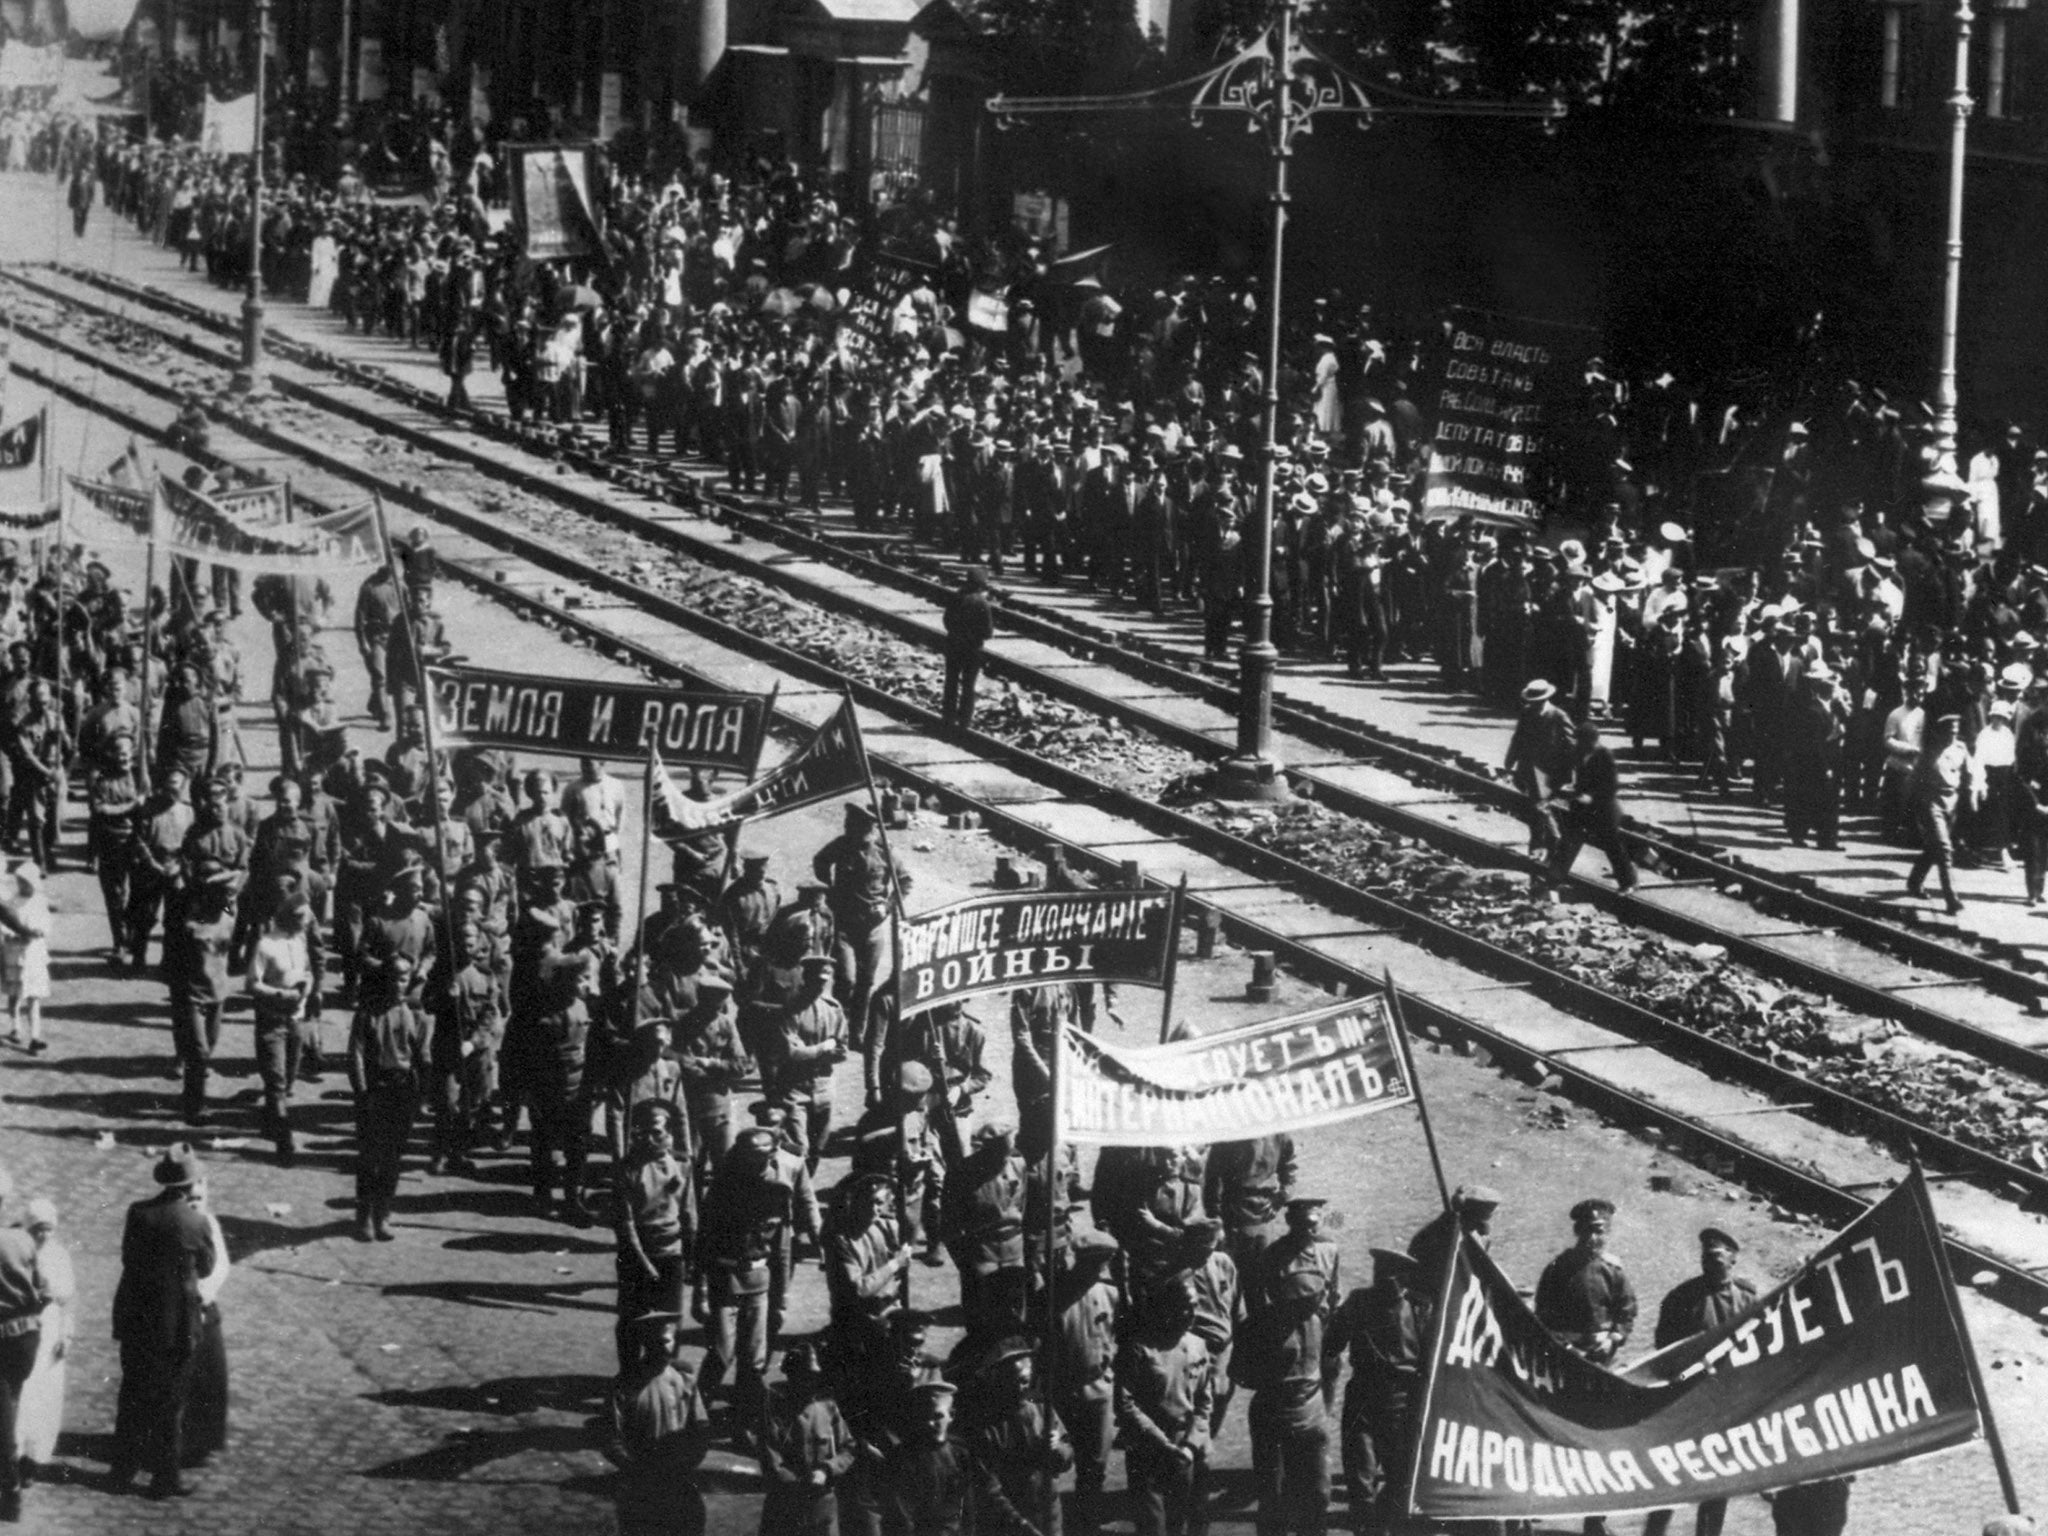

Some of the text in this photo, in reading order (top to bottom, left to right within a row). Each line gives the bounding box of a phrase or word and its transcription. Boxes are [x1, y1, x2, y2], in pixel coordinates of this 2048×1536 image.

[438, 680, 564, 739] ЗЕМЛЯ
[588, 696, 615, 743] И
[638, 700, 745, 754] ВОЛЯ
[916, 944, 1094, 999] ВОЙНЫ
[1446, 1273, 1504, 1368] ДА
[1429, 1363, 1938, 1497] НАРОДНАЯ РЕСПУБЛИКА
